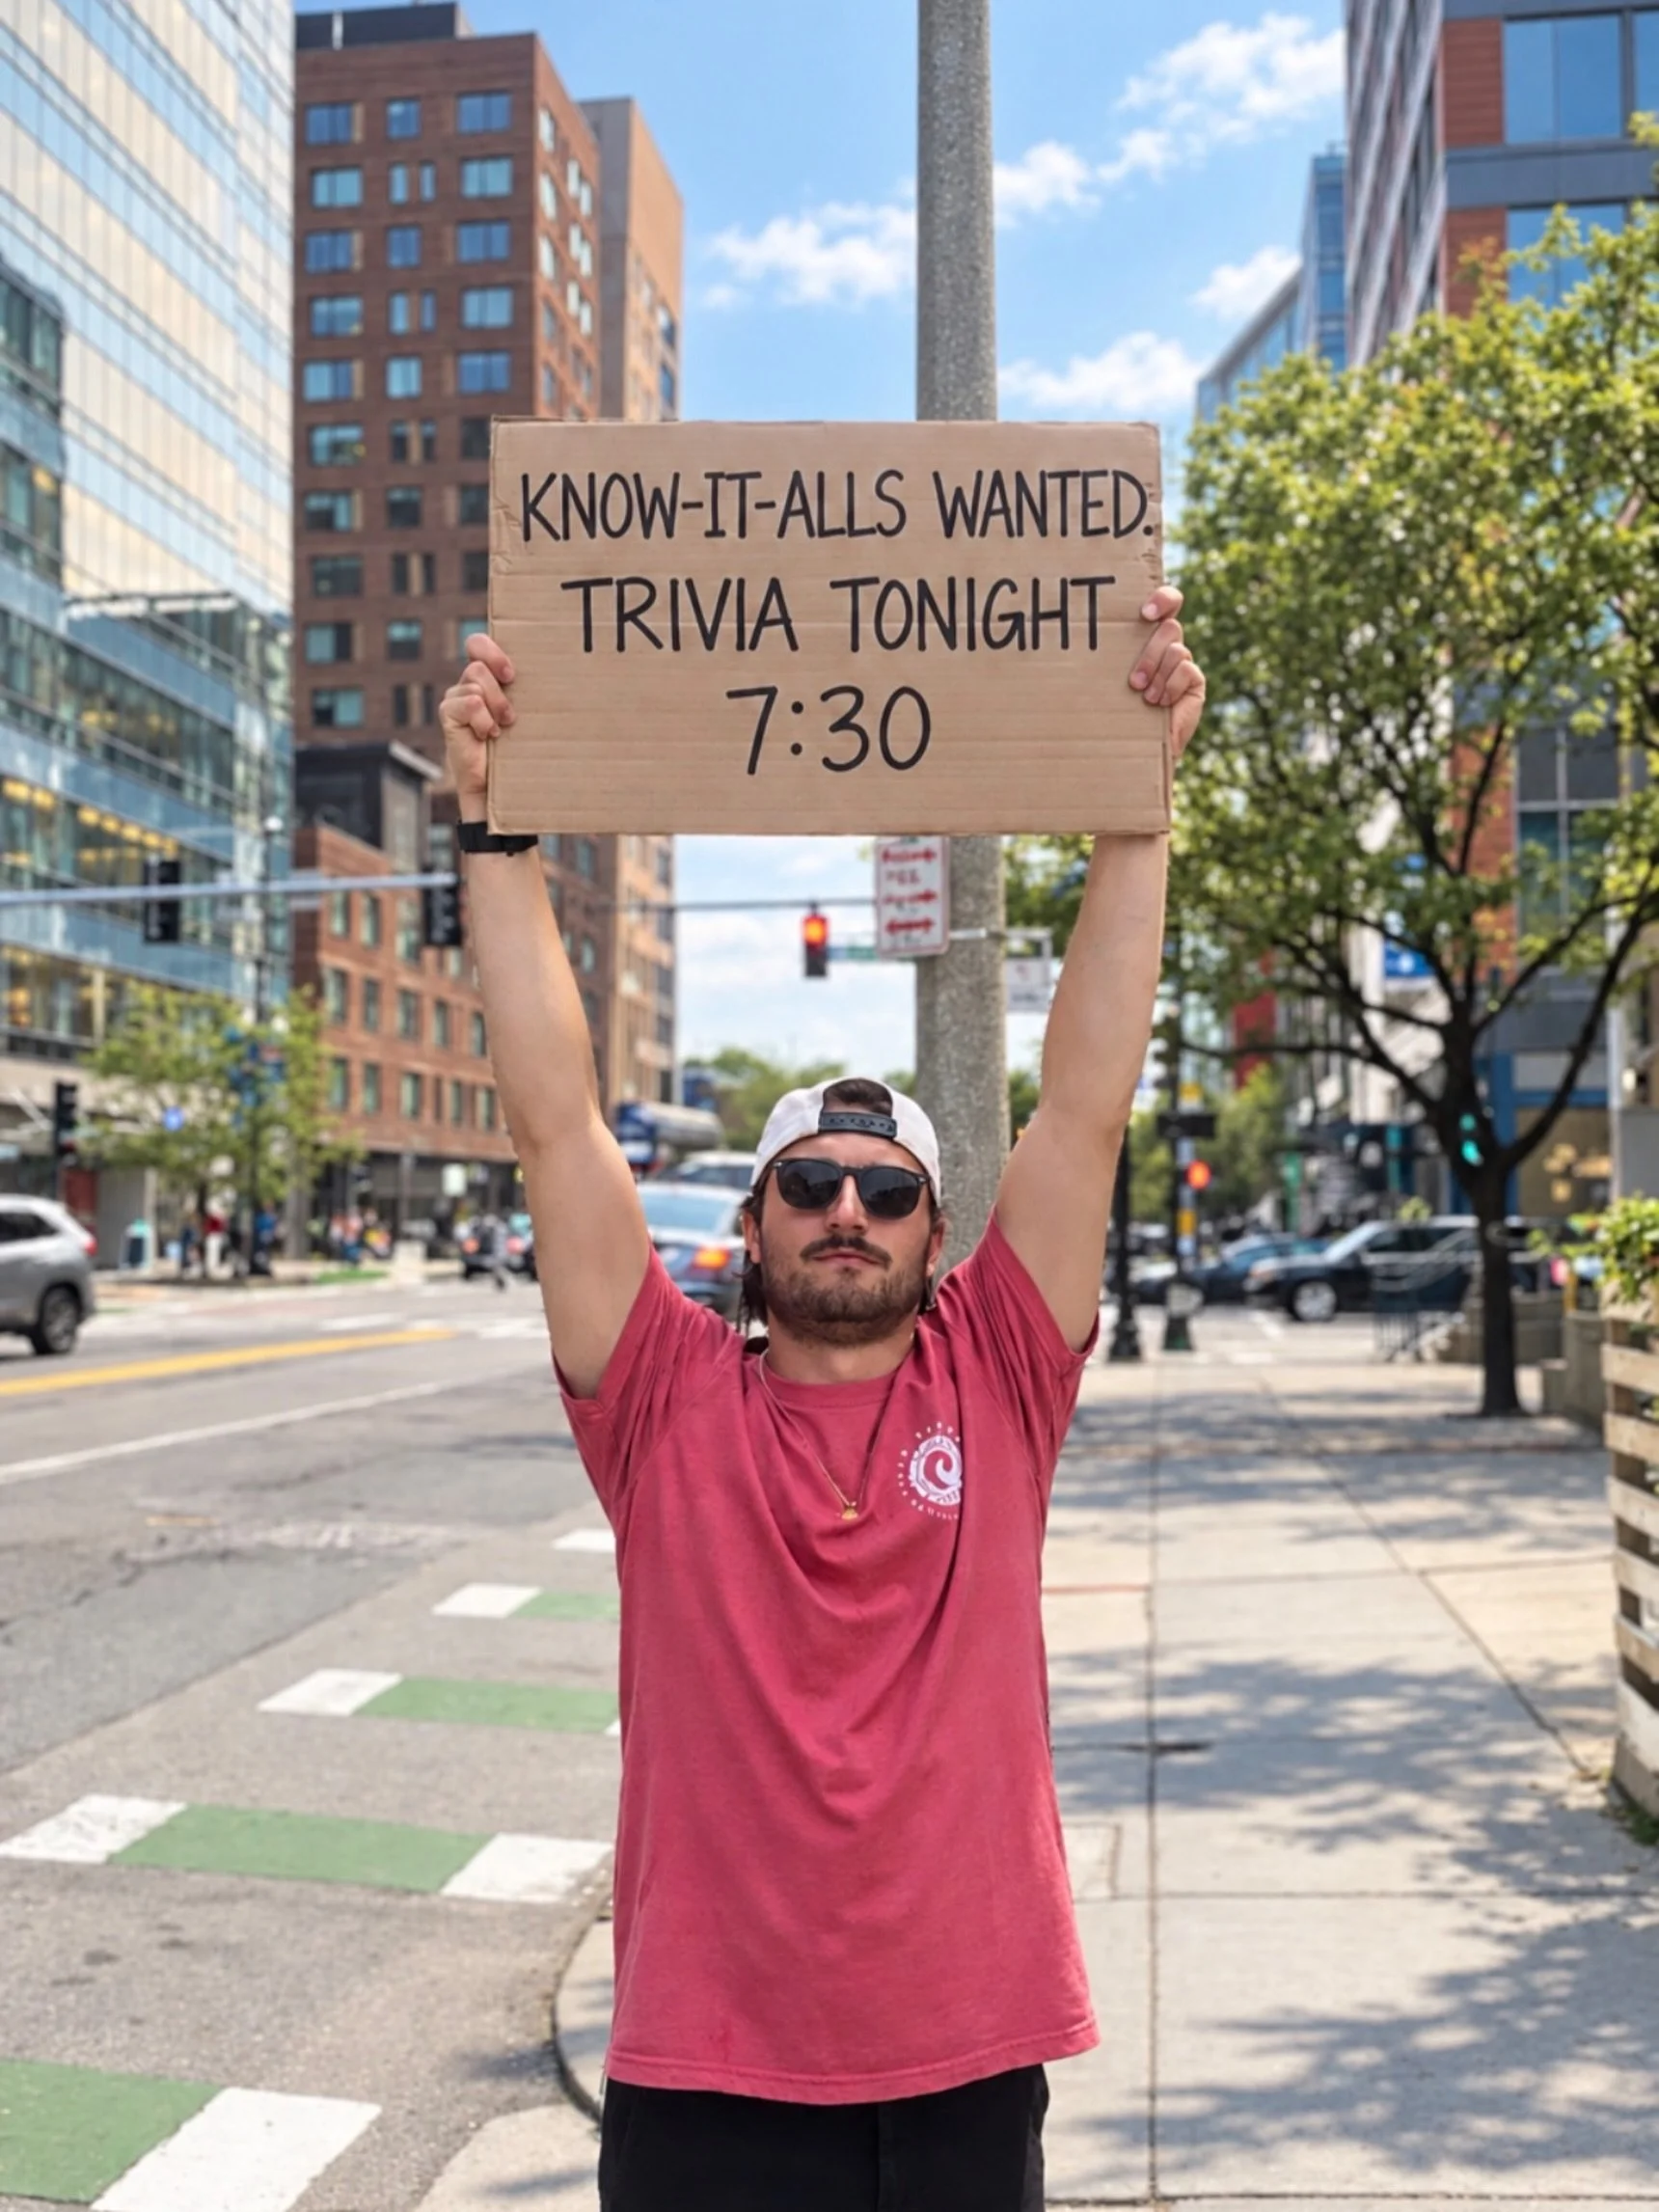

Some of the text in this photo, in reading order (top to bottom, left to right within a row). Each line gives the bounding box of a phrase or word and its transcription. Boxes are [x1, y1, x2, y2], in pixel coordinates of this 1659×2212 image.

[522, 469, 1155, 542] KNOW-IT-ALLS WANTED.
[560, 575, 1116, 653] TRIVIA TONIGHT
[725, 685, 932, 776] 7:30
